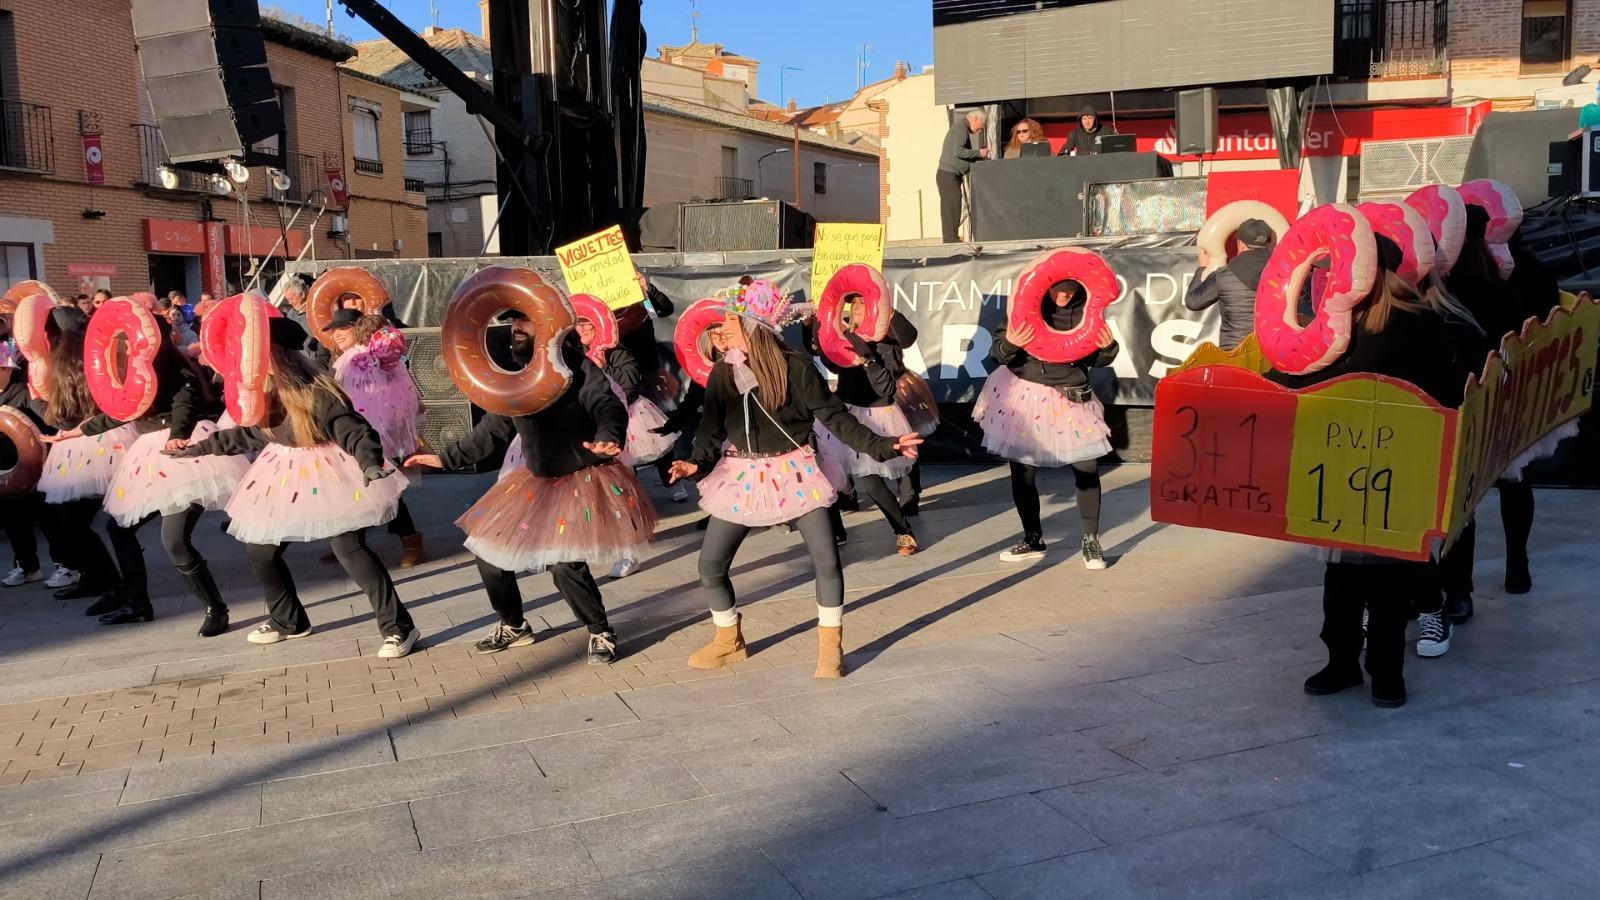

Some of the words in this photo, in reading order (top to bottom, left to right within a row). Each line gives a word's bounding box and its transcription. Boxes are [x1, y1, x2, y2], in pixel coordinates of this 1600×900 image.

[567, 268, 588, 282] Una
[590, 249, 625, 273] amistad
[1327, 422, 1394, 450] P.V.P.
[1160, 478, 1272, 514] GRATIS
[1308, 463, 1393, 533] 1,99
